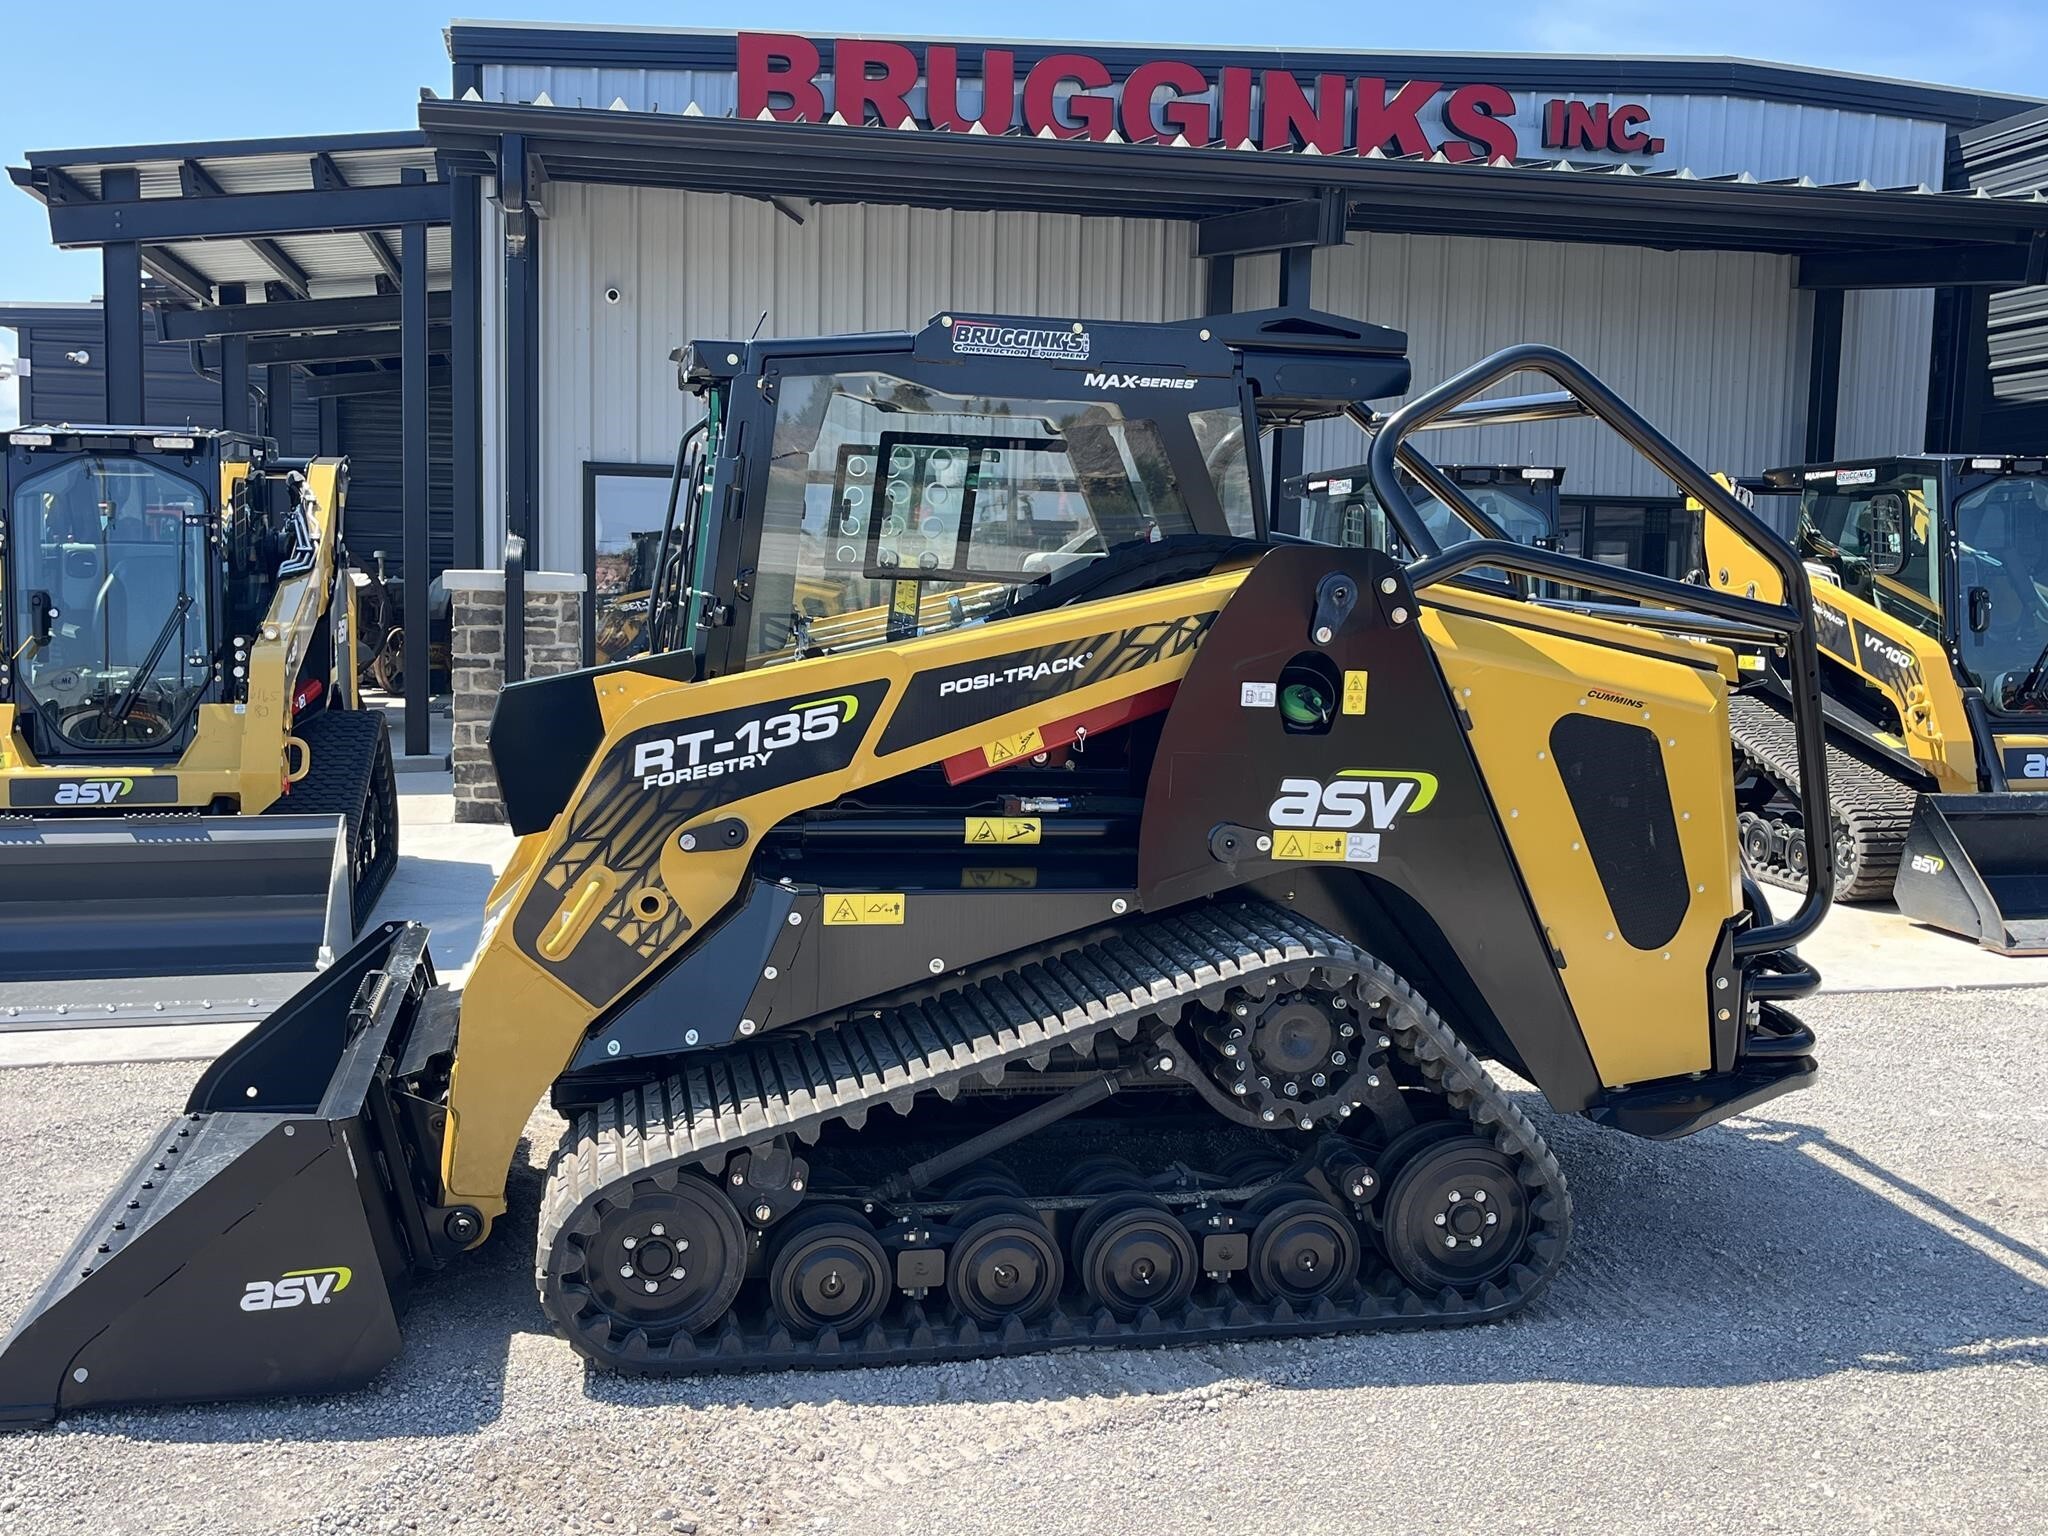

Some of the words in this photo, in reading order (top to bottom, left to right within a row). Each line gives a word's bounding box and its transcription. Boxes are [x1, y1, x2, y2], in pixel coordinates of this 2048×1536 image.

[737, 31, 1518, 167] BRUGGINKS
[1541, 98, 1665, 155] INC.
[952, 344, 1028, 357] CONSTRUCTION
[1031, 348, 1089, 360] EQUIPMENT
[953, 325, 1084, 351] BRUGGINK'S
[1864, 632, 1911, 668] VT-100
[1587, 690, 1644, 709] CUMMINS
[633, 703, 839, 777] RT-135
[642, 750, 774, 791] FORESTRY
